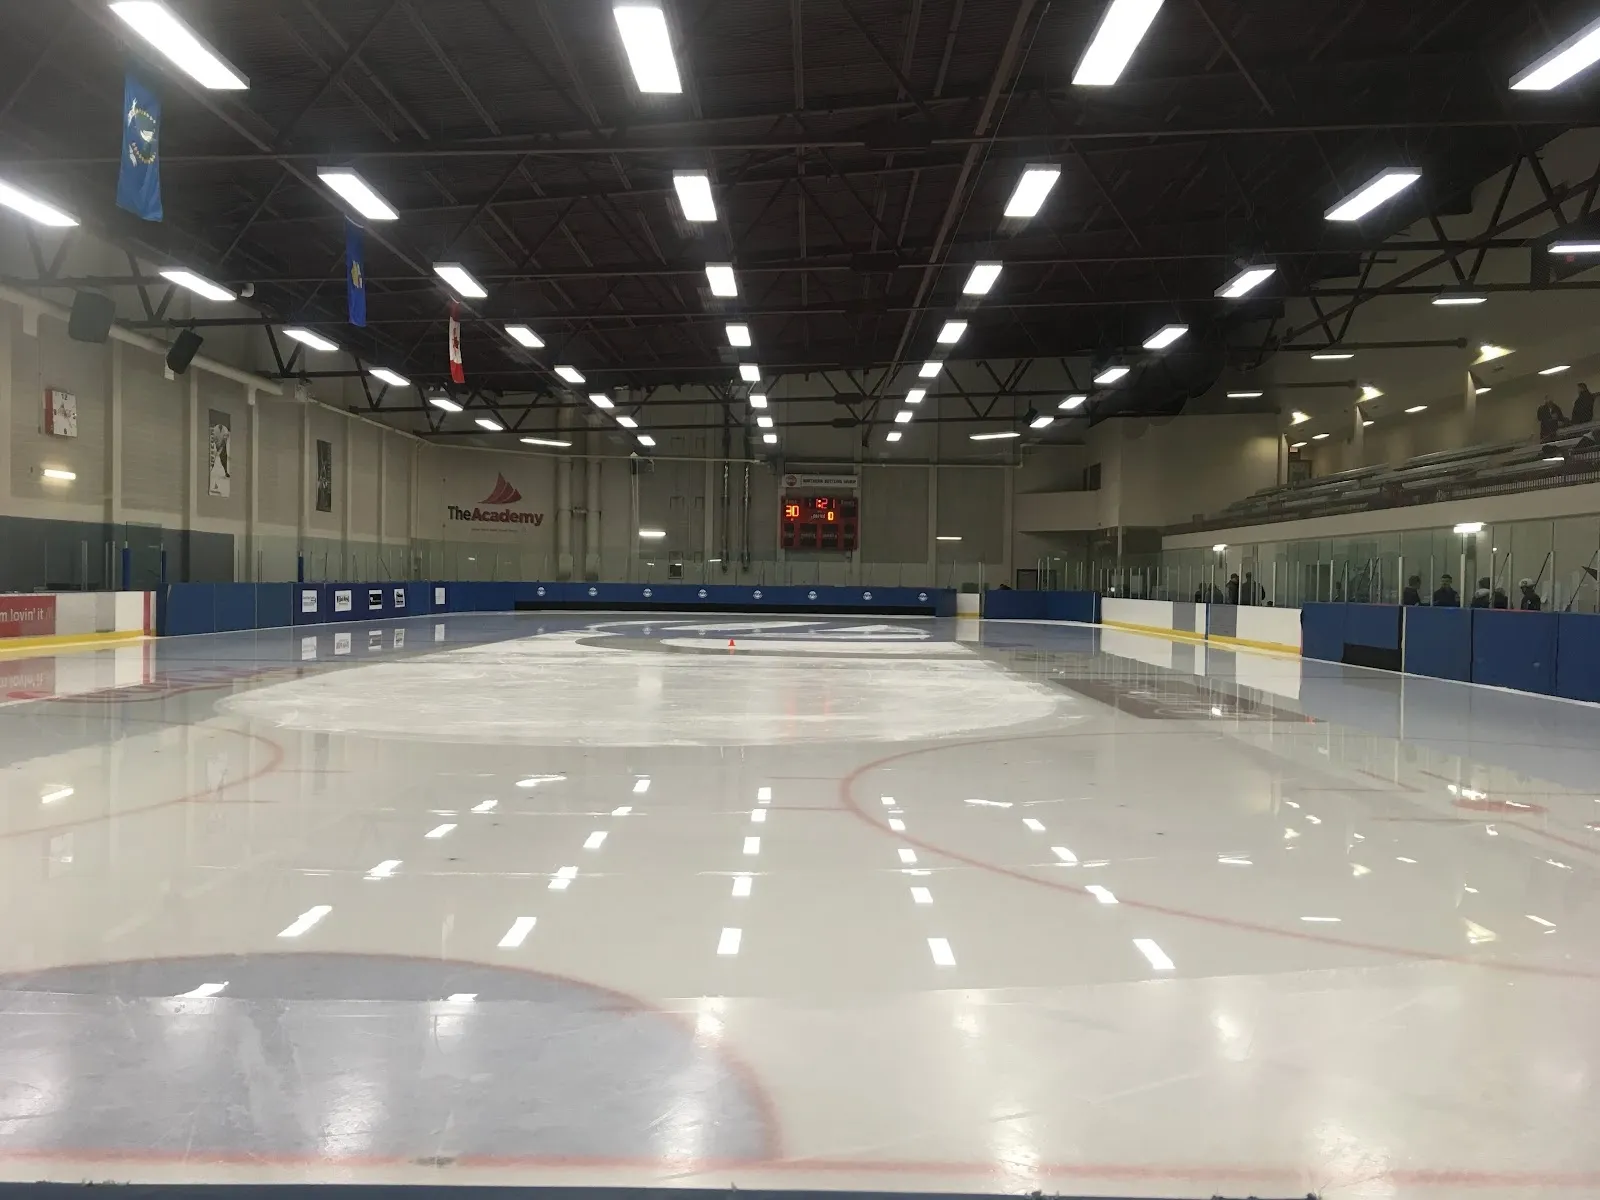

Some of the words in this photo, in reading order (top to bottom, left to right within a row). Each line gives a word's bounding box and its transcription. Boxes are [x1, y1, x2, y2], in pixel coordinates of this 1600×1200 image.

[785, 505, 800, 517] 30
[827, 511, 834, 520] 0
[10, 607, 36, 622] lovin'
[37, 607, 44, 620] it
